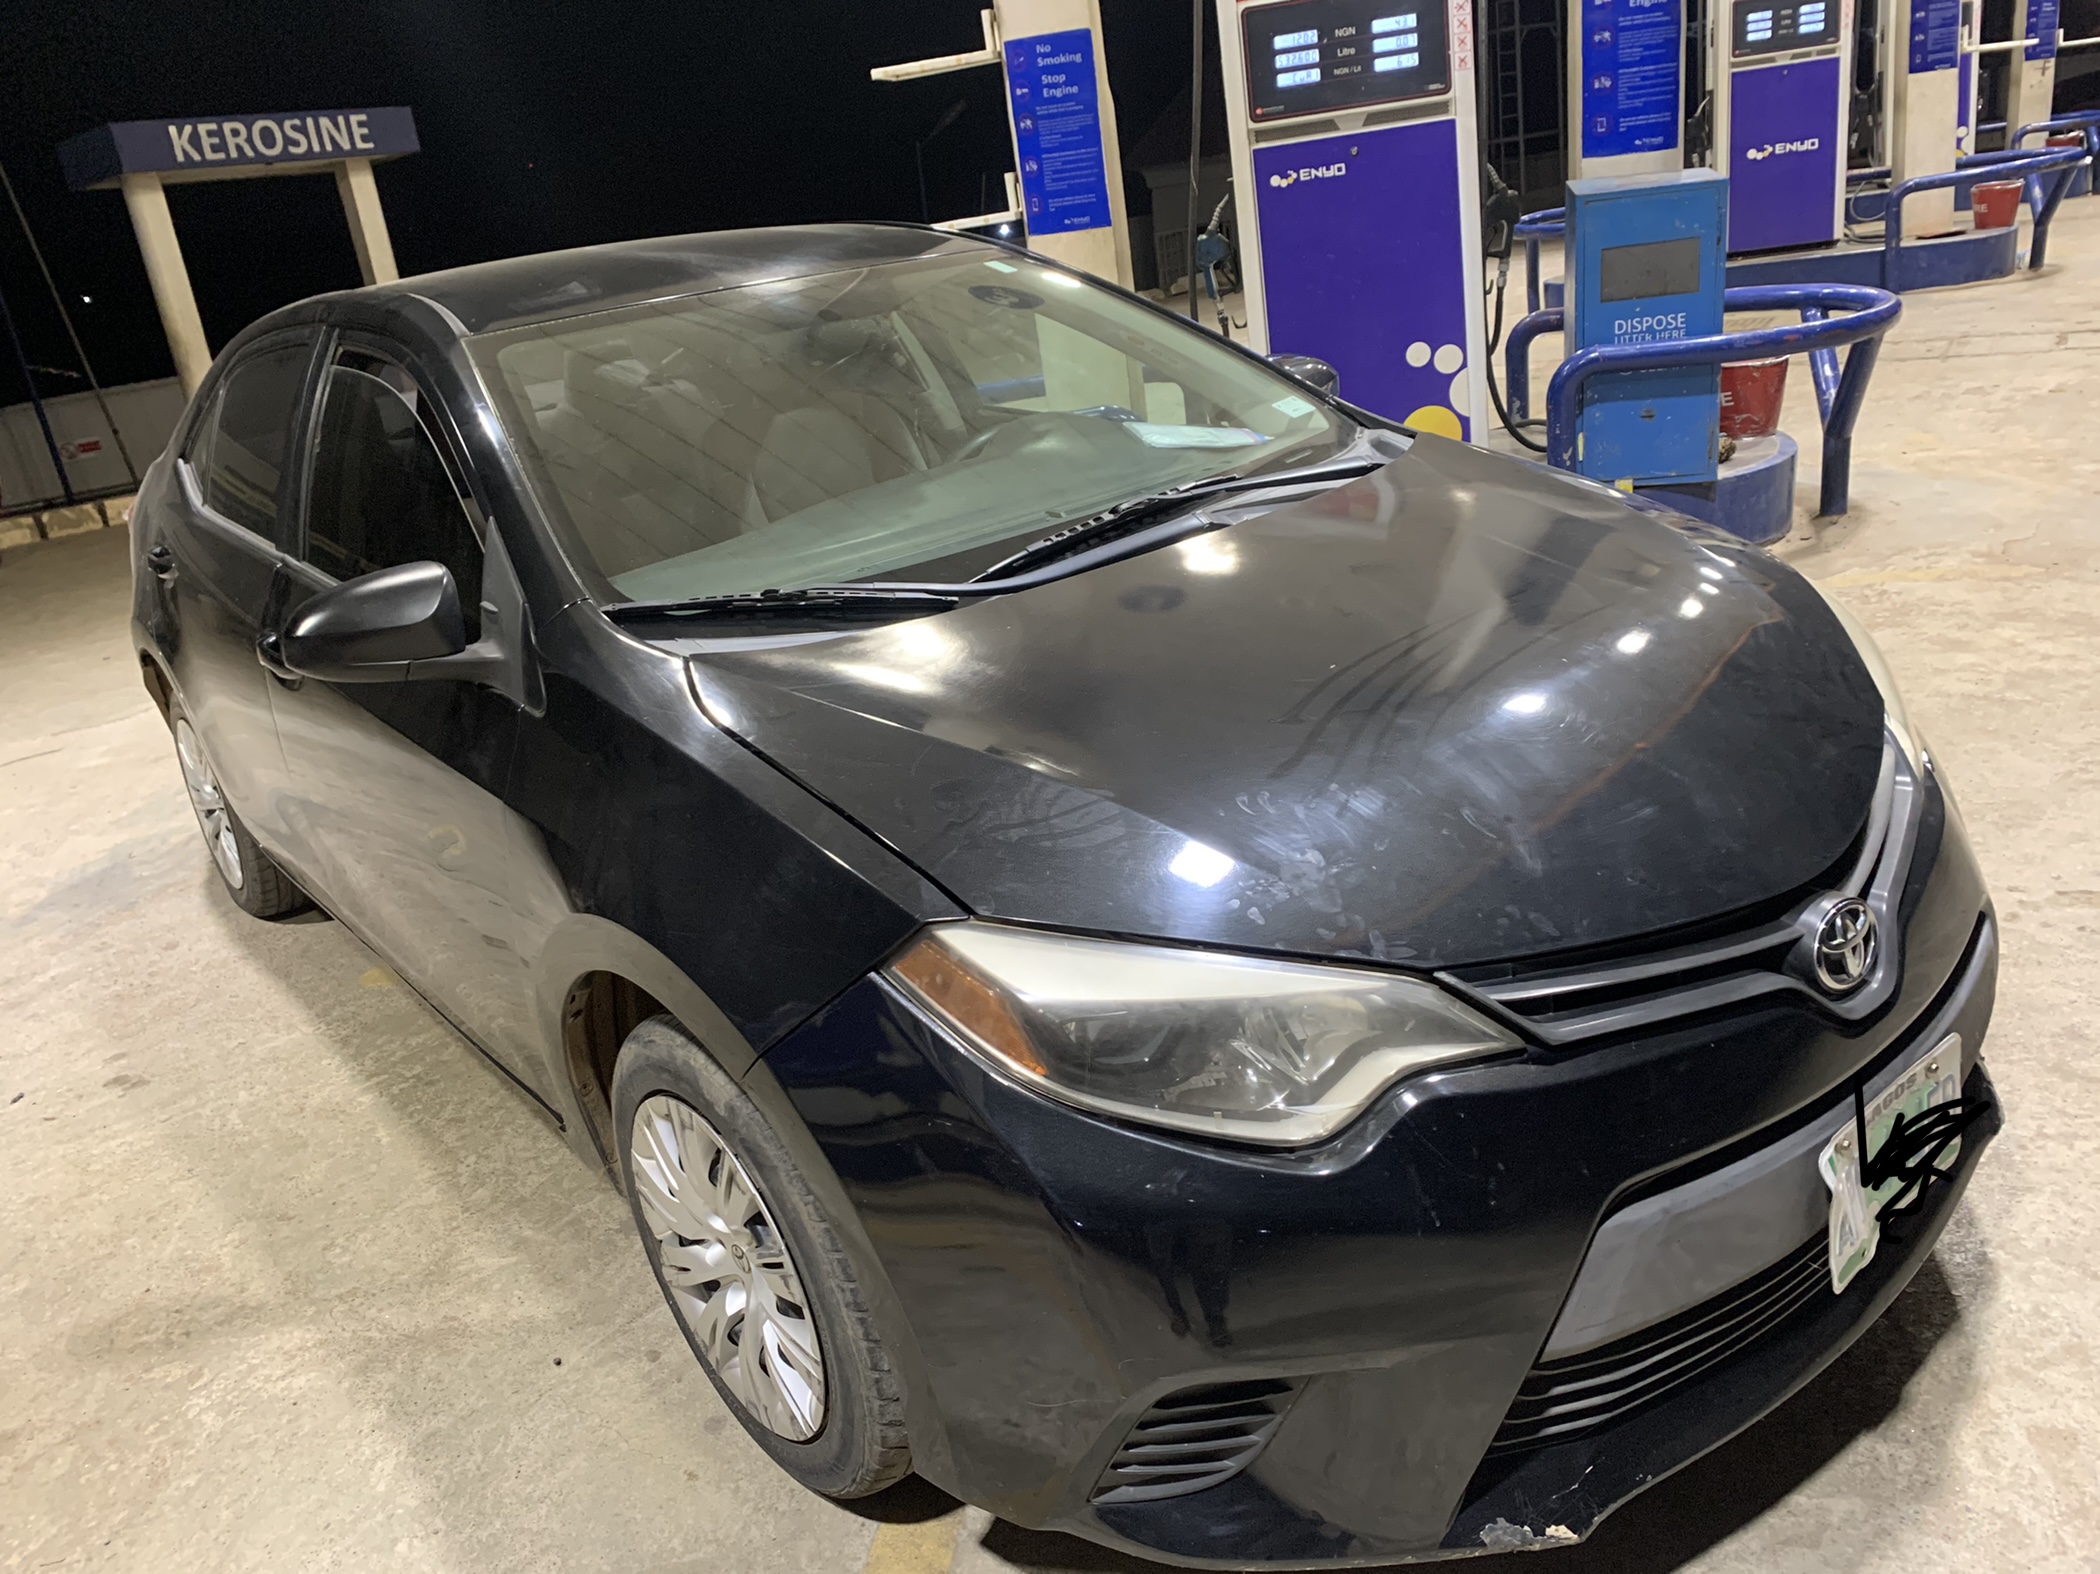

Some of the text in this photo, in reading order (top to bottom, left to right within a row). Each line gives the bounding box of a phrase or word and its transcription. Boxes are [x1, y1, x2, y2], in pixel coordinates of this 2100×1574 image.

[1629, 0, 1668, 8] Eng
[1335, 26, 1356, 37] NGN
[1036, 43, 1052, 54] No
[1037, 52, 1083, 67] Smoking
[1041, 73, 1066, 85] Stop
[1043, 85, 1079, 98] Engine
[168, 113, 374, 162] KEROSINE
[1774, 138, 1819, 155] ENYO
[1299, 162, 1346, 181] ENYO
[1614, 312, 1687, 335] DISPOSE
